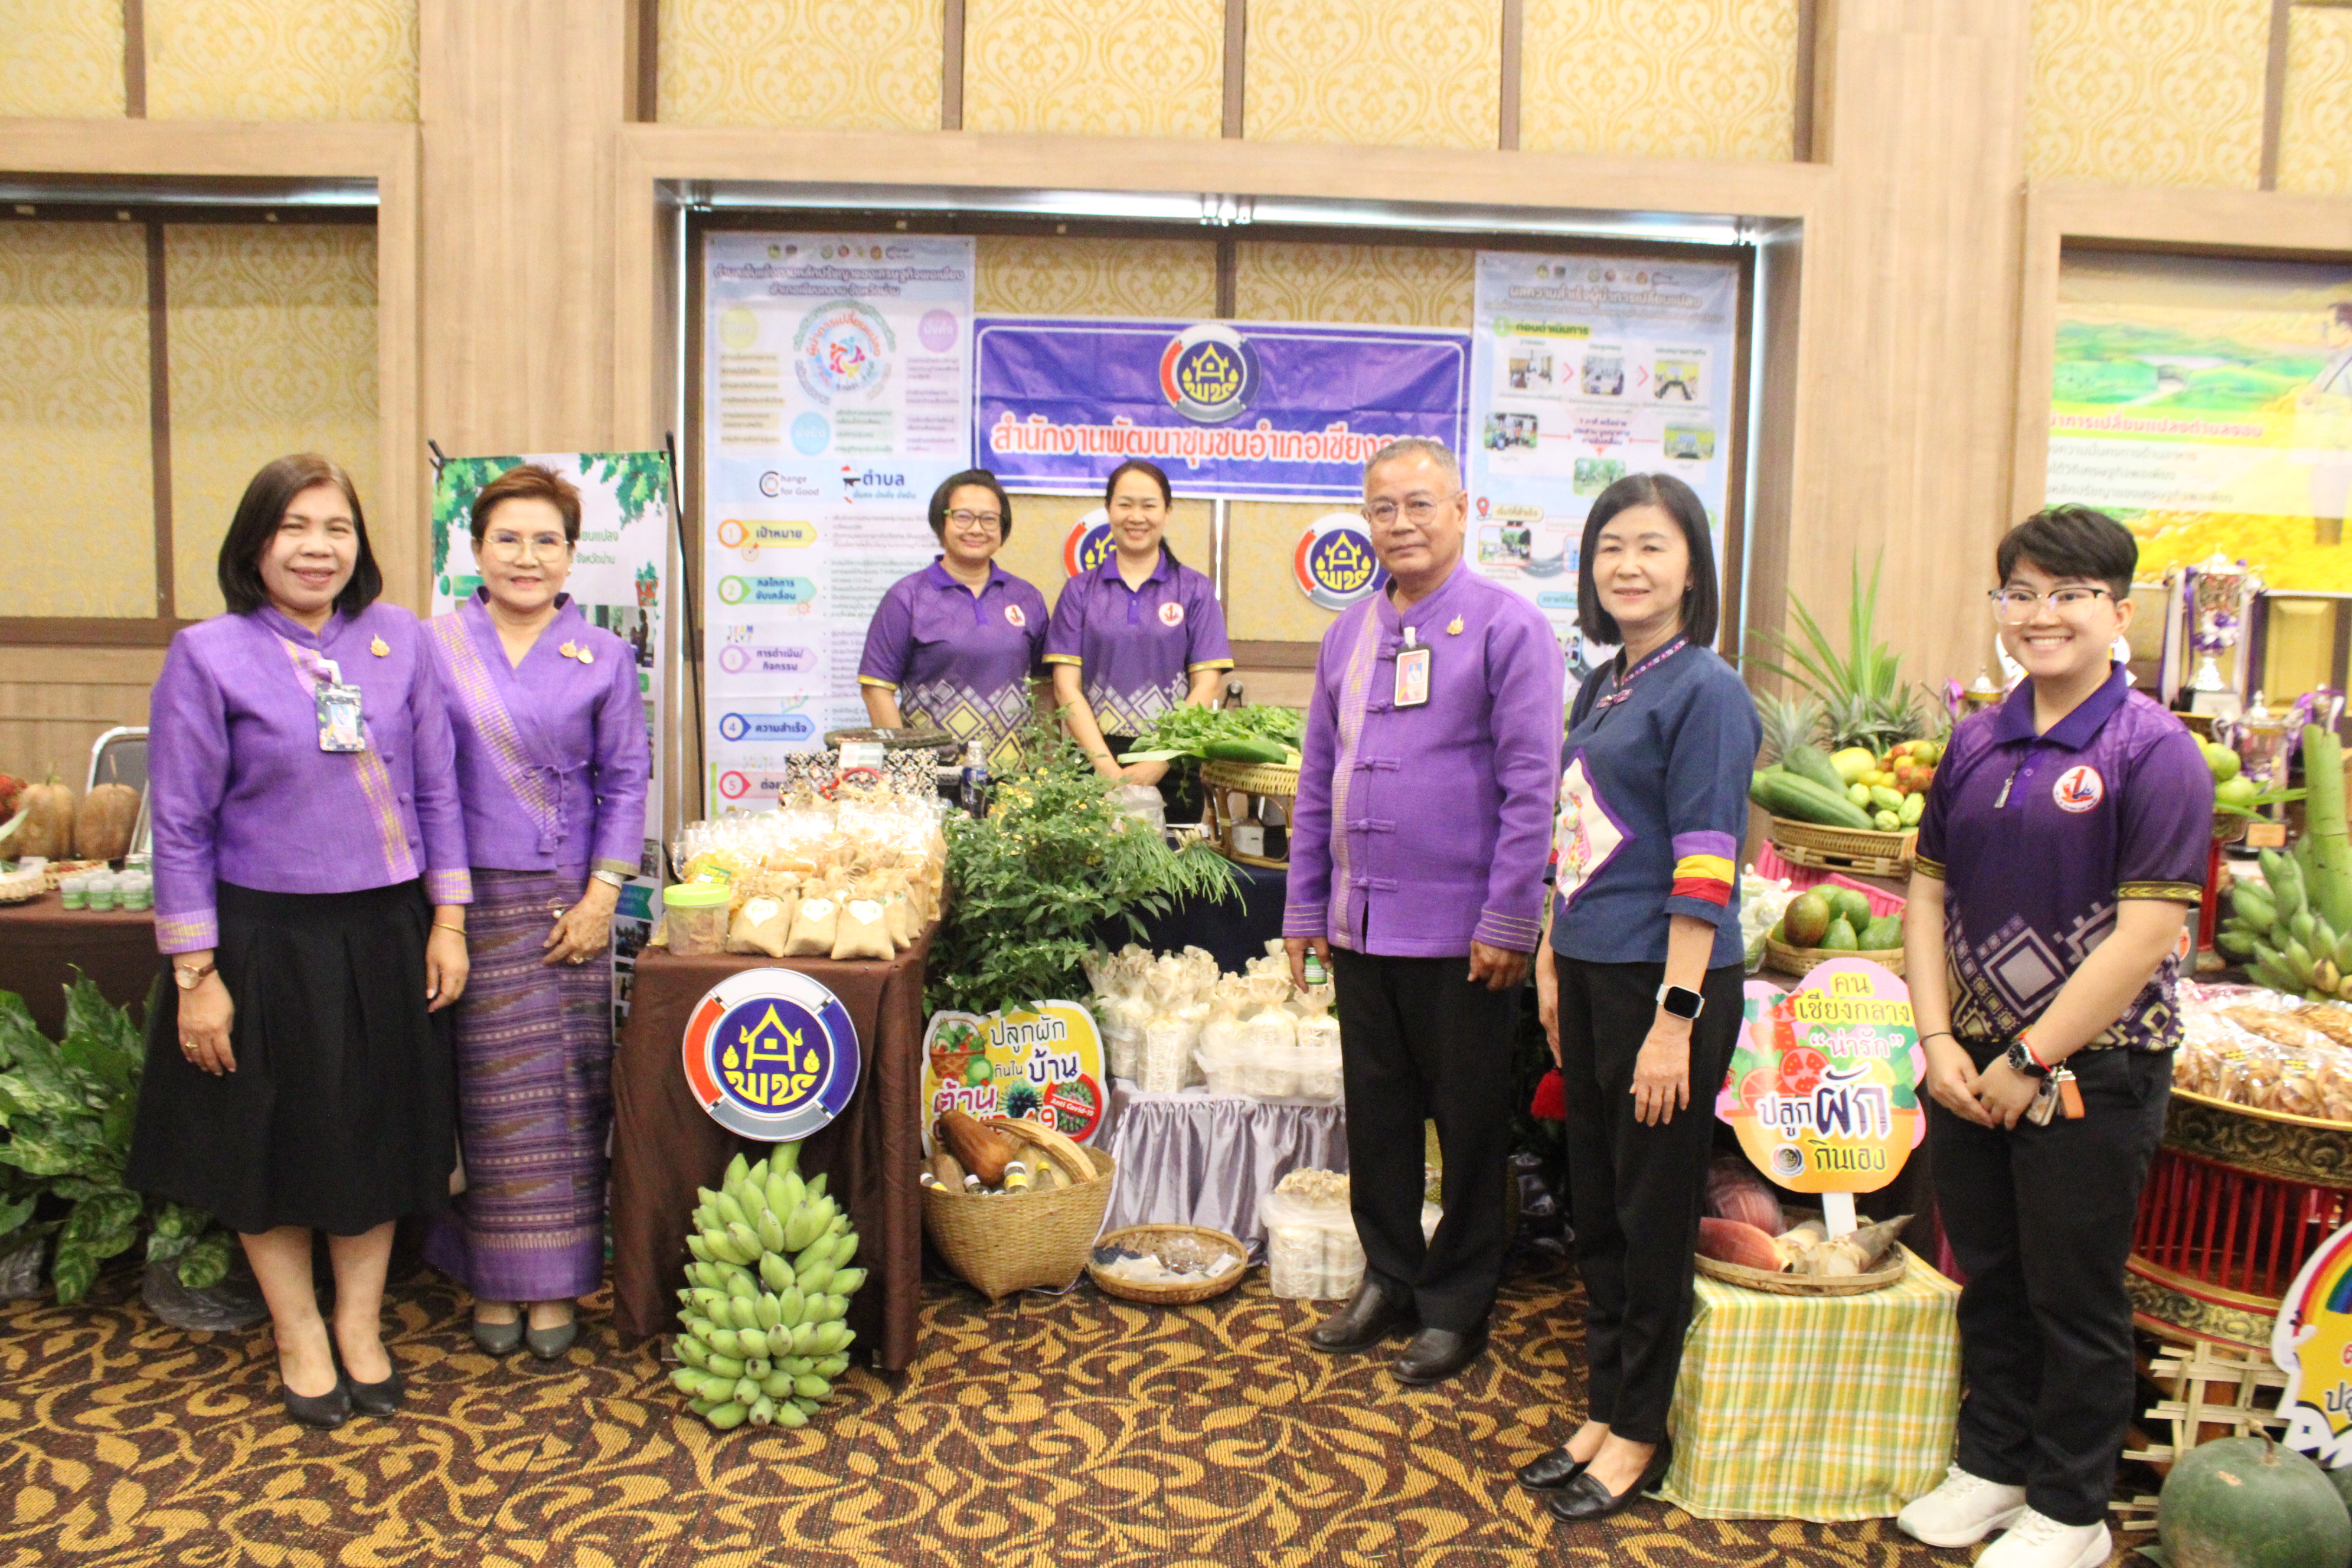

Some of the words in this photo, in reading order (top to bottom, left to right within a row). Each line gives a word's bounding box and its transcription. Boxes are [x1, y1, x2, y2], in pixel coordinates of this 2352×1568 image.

[806, 310, 881, 357] ผู้นำการเปลี่ยนแปลง
[994, 414, 1417, 466] สำนักงานพัฒนาชุมชนอำเภอเชียง
[863, 469, 904, 486] ตำบล
[796, 487, 819, 495] Good
[756, 526, 802, 538] เป้าหมาย
[728, 585, 735, 595] 2
[757, 577, 795, 587] กลไกการ
[756, 589, 796, 600] ขับเคลื่อน
[763, 661, 798, 671] กิจกรรม
[729, 722, 736, 733] 4
[755, 721, 807, 733] ความสำเร็จ
[729, 780, 736, 791] 5
[1835, 975, 1870, 994] คน
[1799, 992, 1911, 1022] เชียงกลาง
[991, 1016, 1065, 1053] ปลูกผัก
[994, 1060, 1024, 1078] กินใน
[1028, 1048, 1077, 1083] บ้าน
[933, 1081, 996, 1113] ต้าน
[1050, 1097, 1066, 1108] Anti
[1066, 1102, 1095, 1117] Covid-19
[1808, 1139, 1887, 1171] กินเอง
